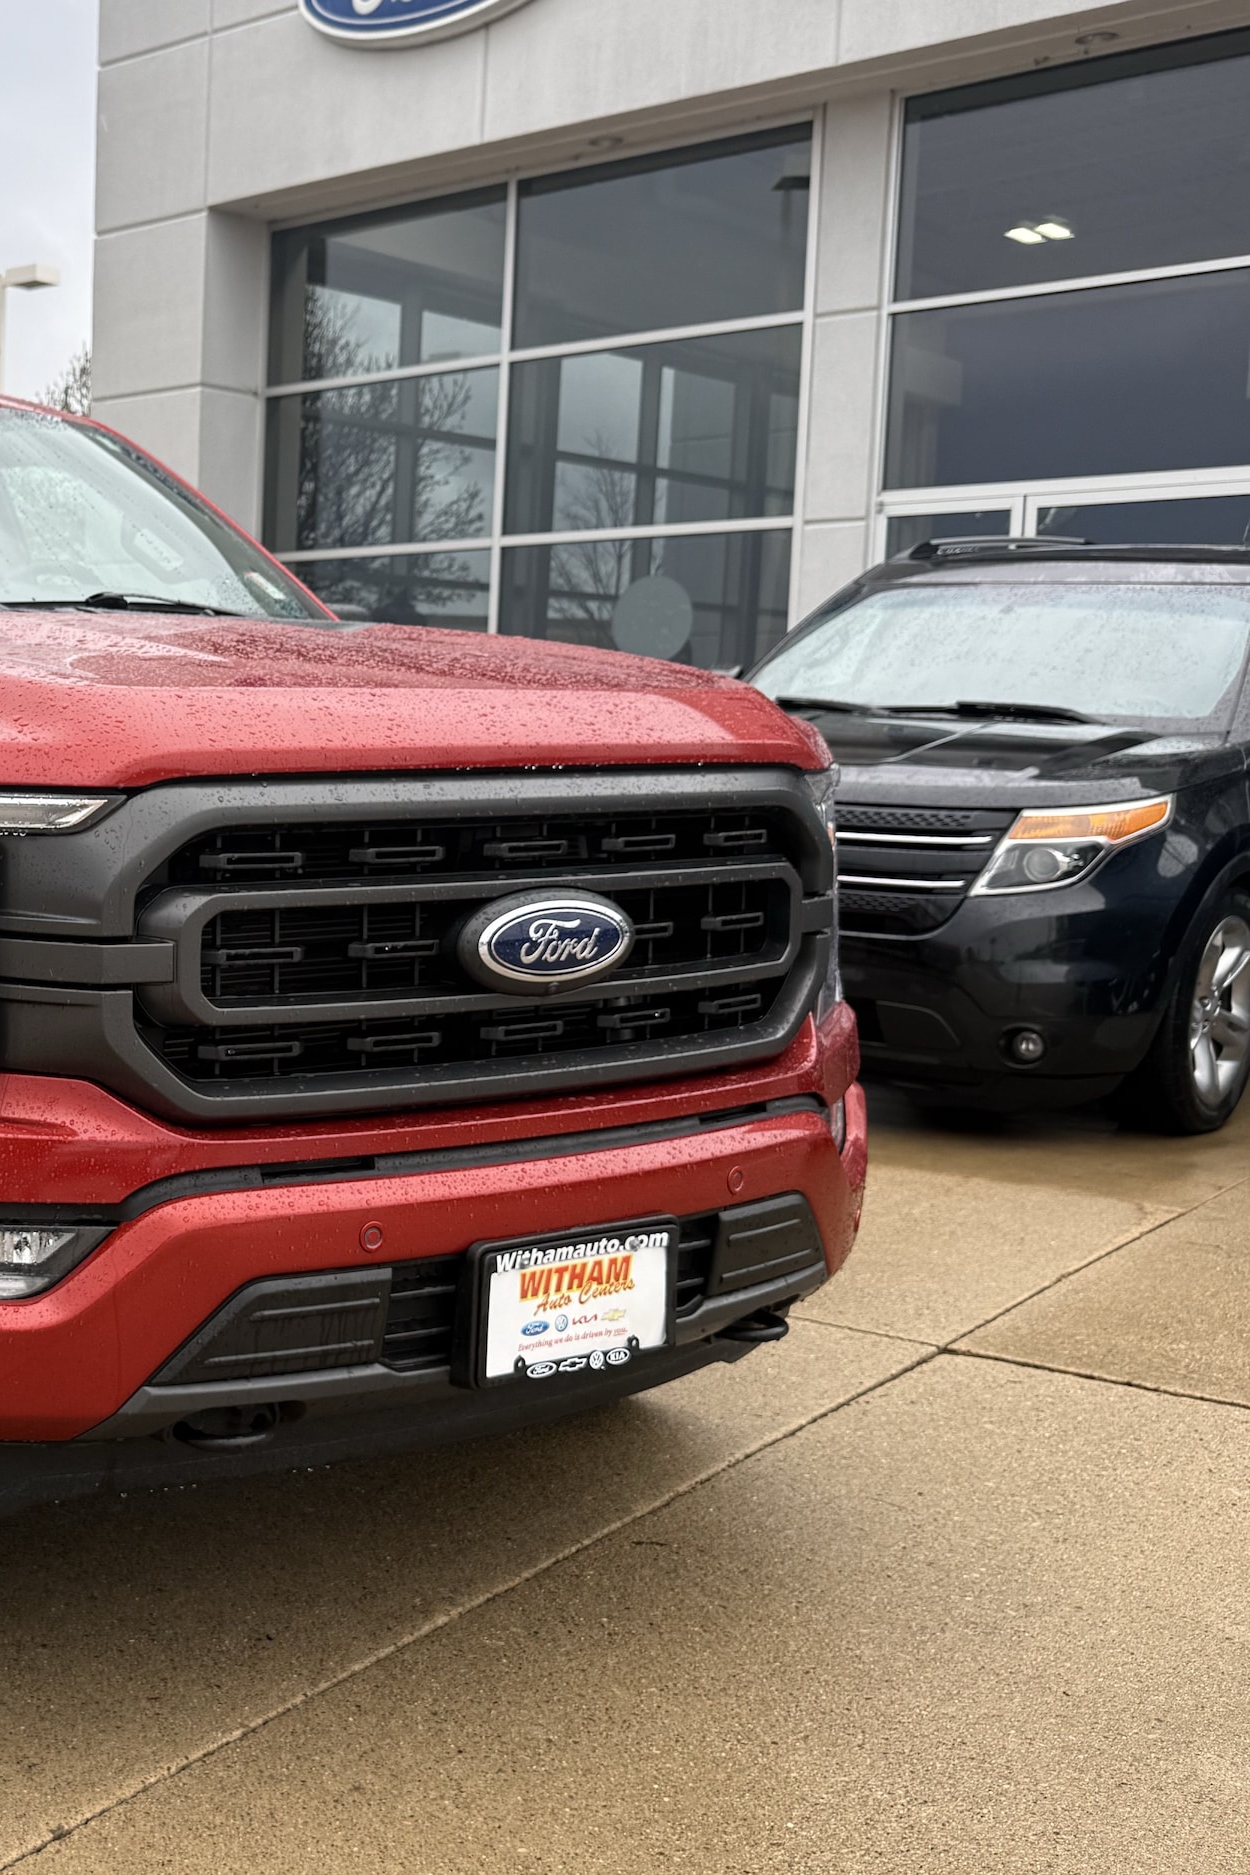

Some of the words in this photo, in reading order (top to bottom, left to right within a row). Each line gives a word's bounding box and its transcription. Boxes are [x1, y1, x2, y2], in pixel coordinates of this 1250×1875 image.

[520, 918, 601, 964] Ford
[519, 1254, 633, 1300] WITHAM
[533, 1292, 572, 1316] Auto
[578, 1278, 636, 1304] Centers
[518, 1339, 553, 1352] Everything
[524, 1322, 547, 1335] Ford
